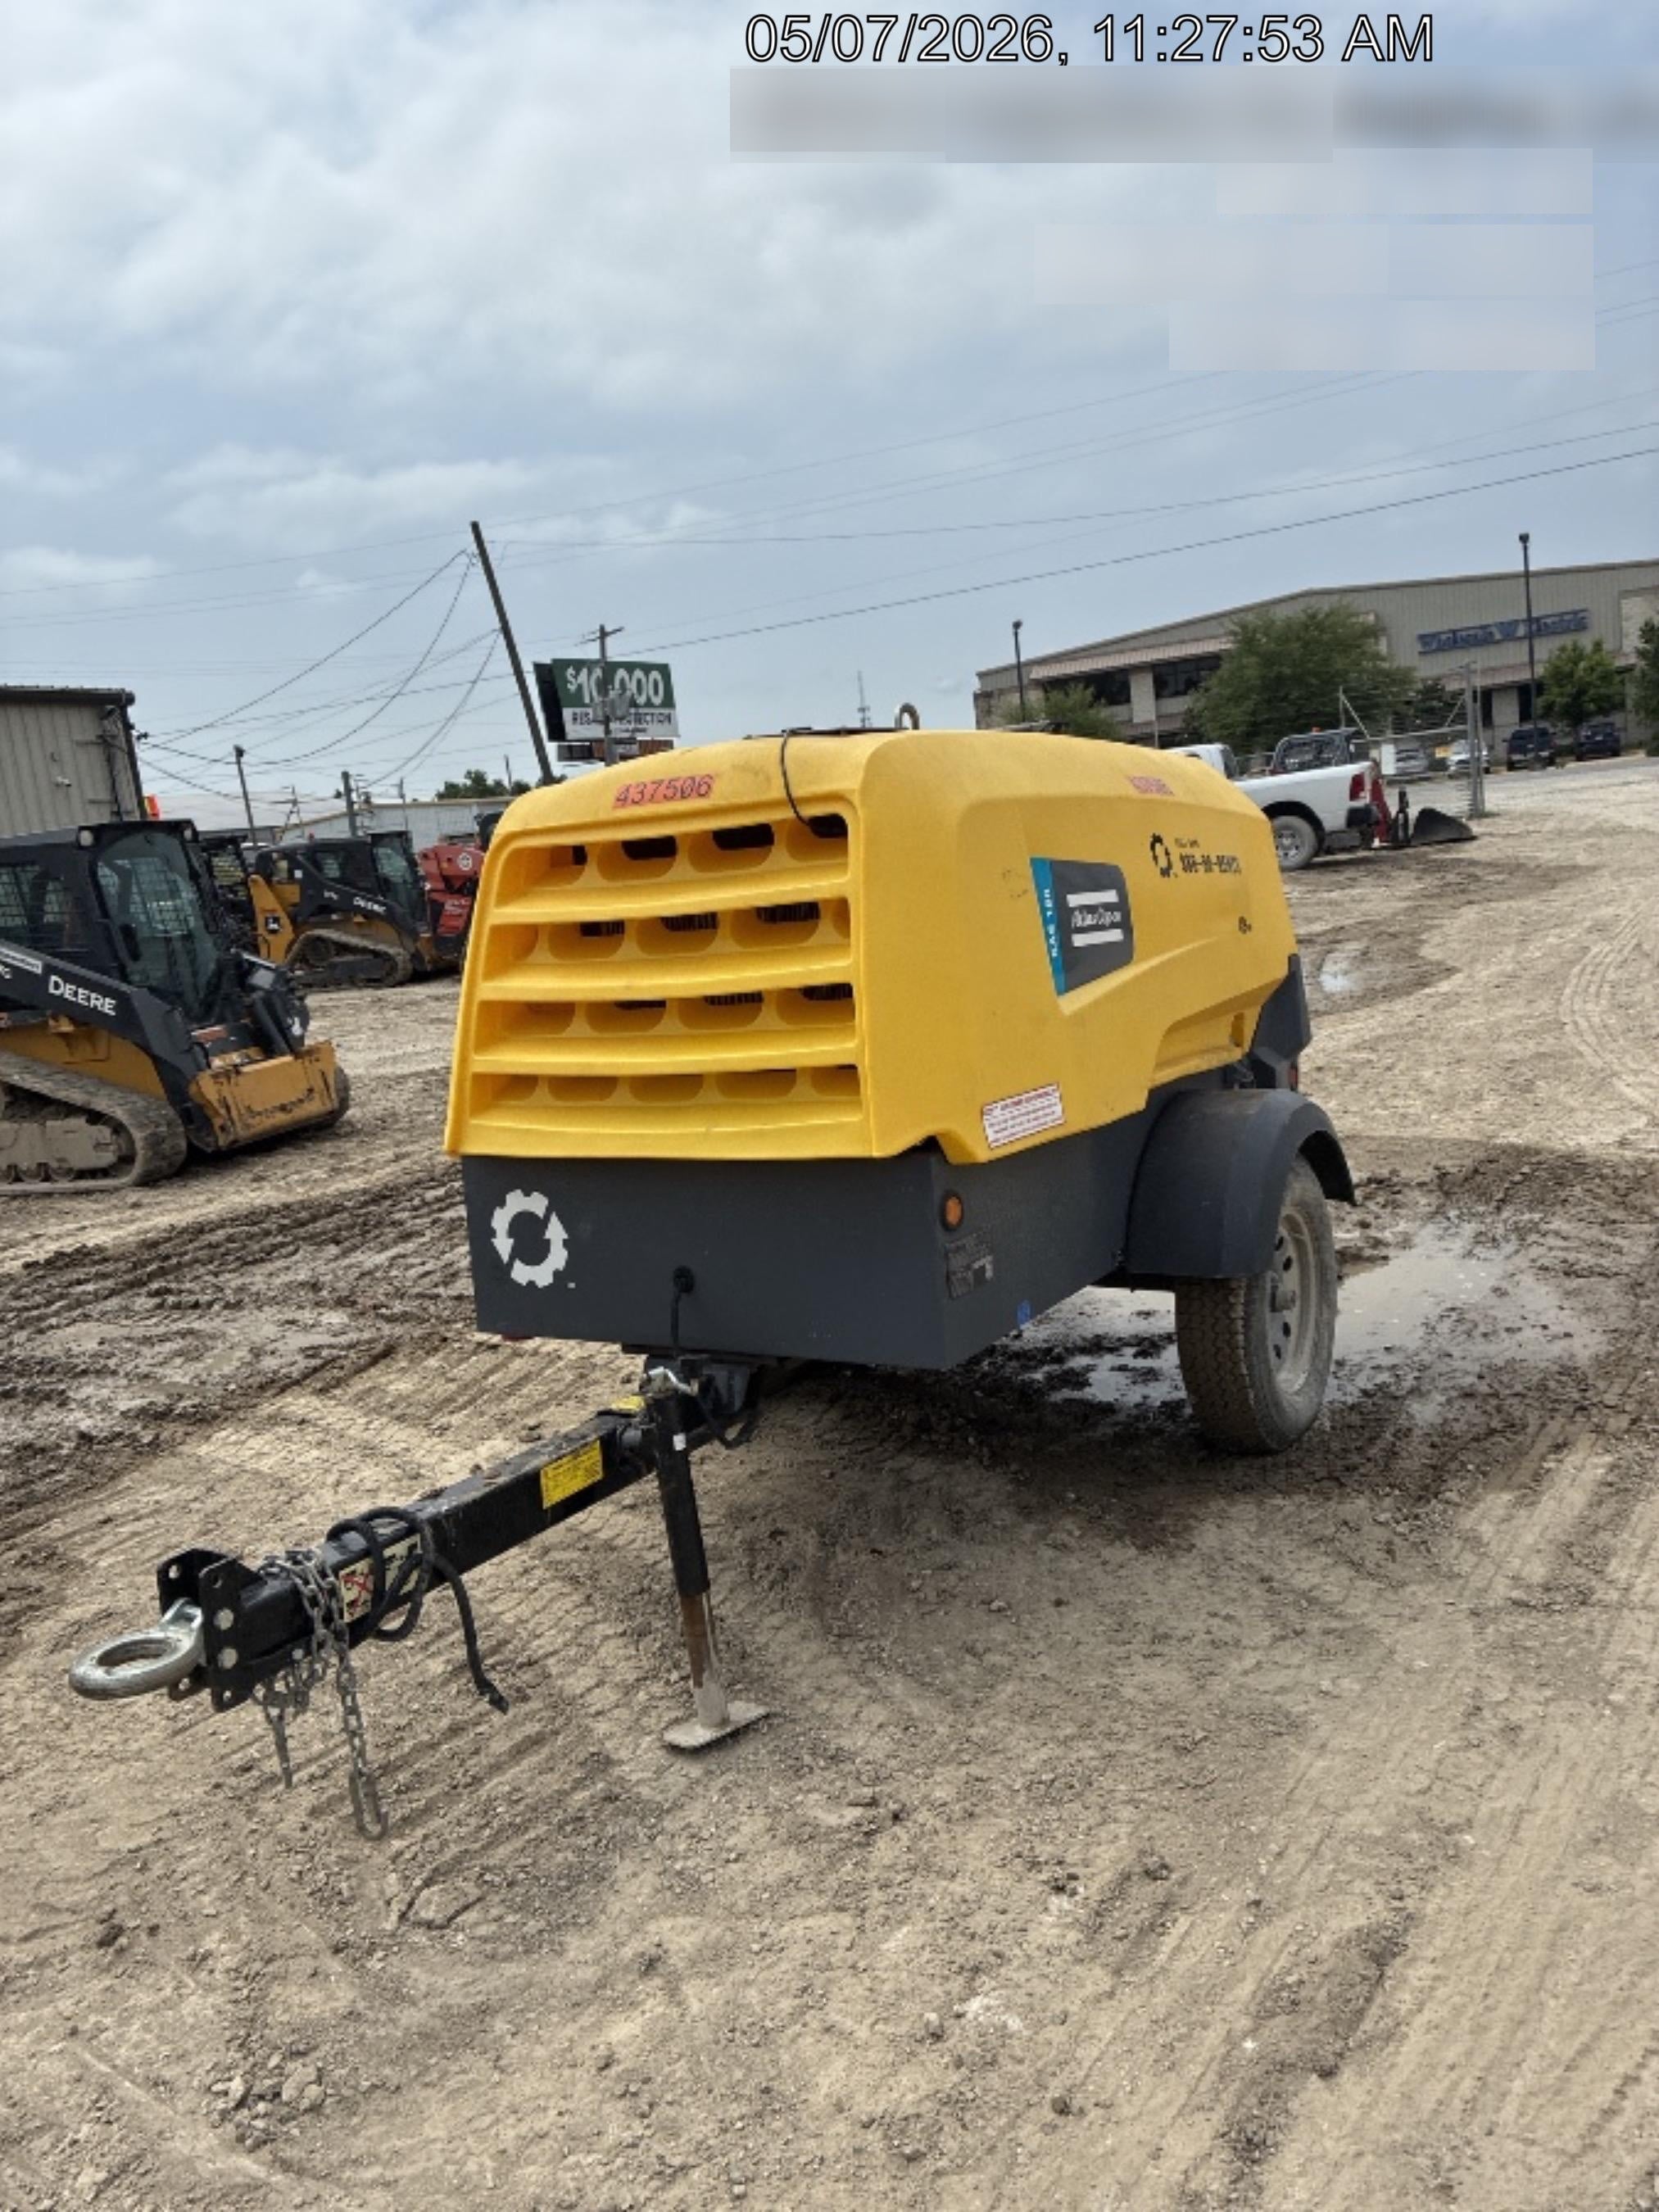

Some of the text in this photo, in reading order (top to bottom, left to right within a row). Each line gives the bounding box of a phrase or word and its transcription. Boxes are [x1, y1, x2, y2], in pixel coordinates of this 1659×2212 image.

[566, 664, 664, 706] $10000
[616, 773, 714, 807] 437506
[48, 975, 116, 1016] DEERE
